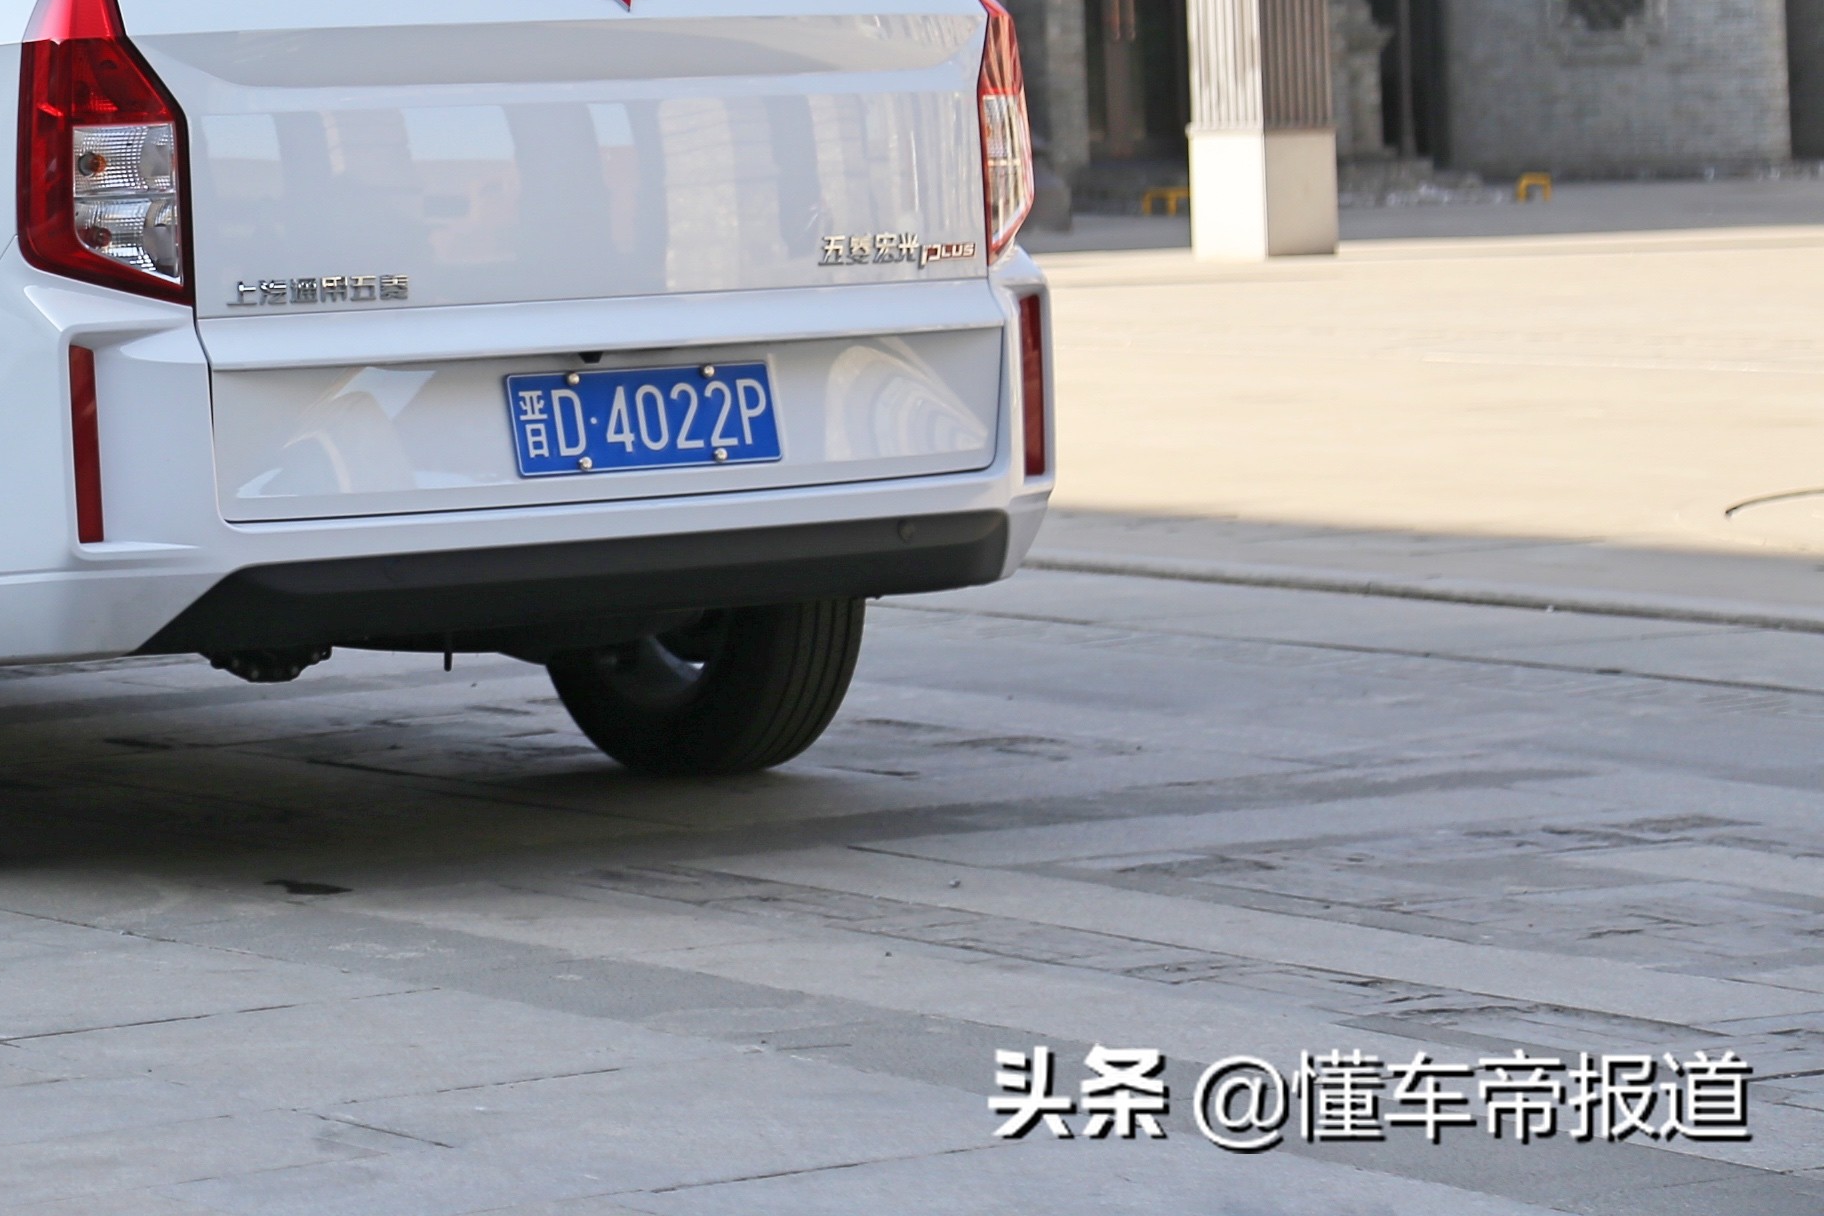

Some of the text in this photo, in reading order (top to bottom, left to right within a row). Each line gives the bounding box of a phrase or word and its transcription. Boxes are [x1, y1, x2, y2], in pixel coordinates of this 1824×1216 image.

[818, 232, 920, 266] 五菱宏光
[226, 274, 409, 306] 上汽通用五菱
